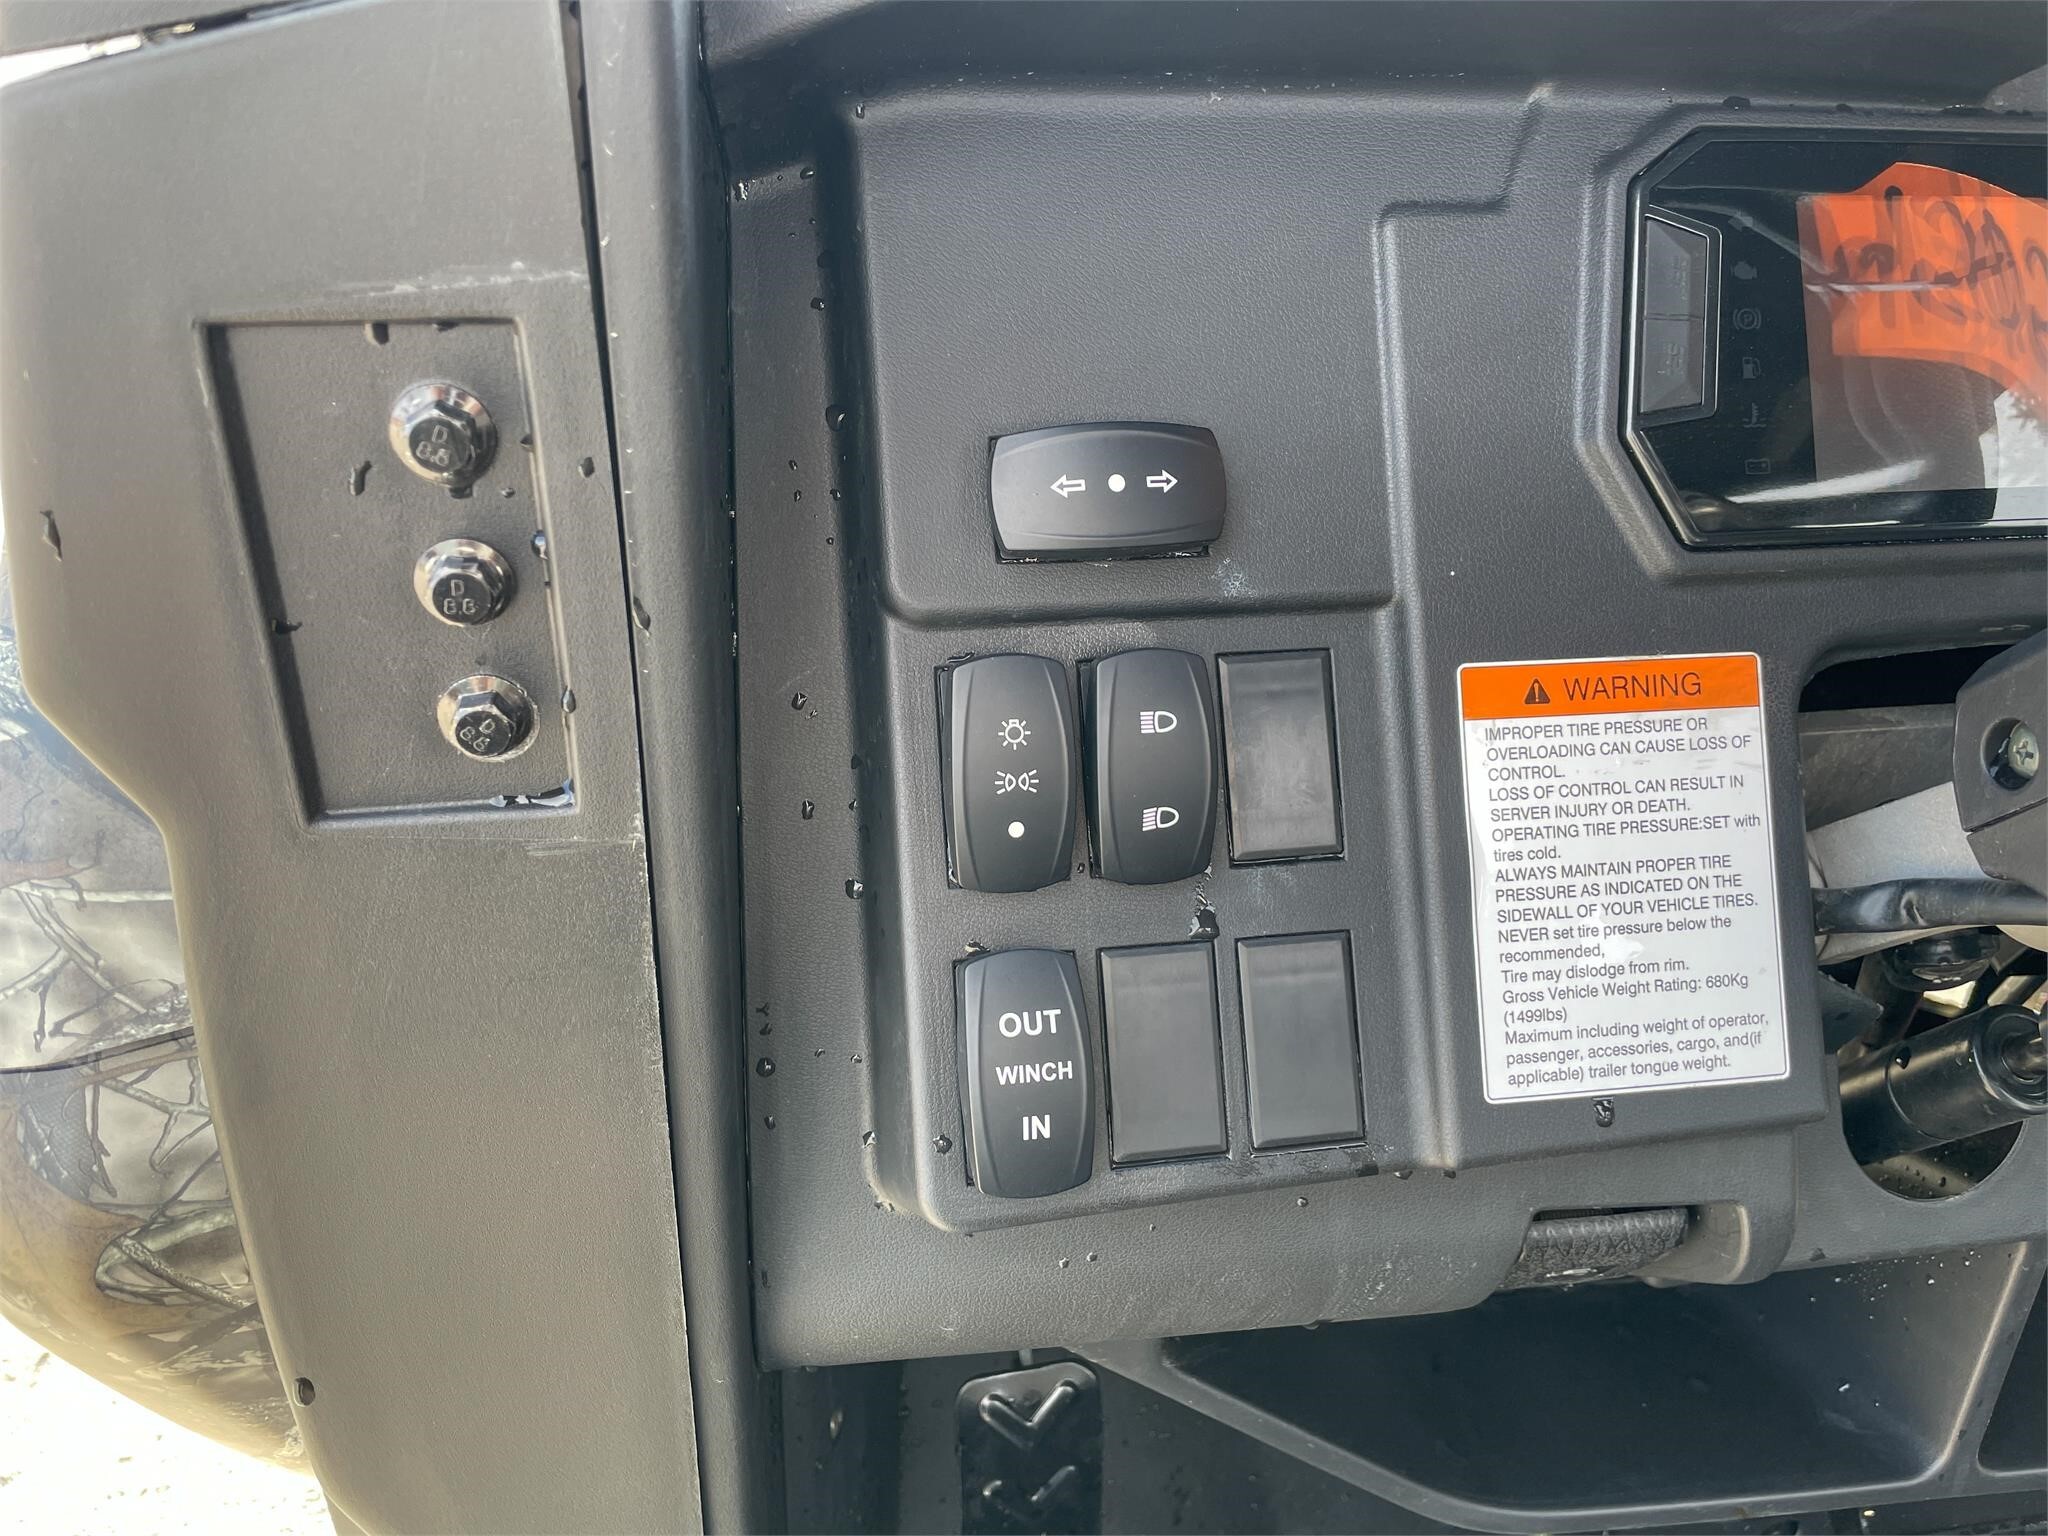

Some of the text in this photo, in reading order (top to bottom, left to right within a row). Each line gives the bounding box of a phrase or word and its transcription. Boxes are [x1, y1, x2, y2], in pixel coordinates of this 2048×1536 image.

[450, 579, 464, 596] D
[1563, 672, 1701, 701] WARNING
[1485, 717, 1708, 741] IMPROPER TIRE PRESSURE OR
[1485, 735, 1752, 762] OVERLOADING CAN CAUSE LOSS OF
[1488, 764, 1566, 782] CONTROL.
[1489, 774, 1744, 802] LOSS OF CONTROL CAN RESULT IN
[1490, 798, 1691, 822] SERVER INJURY OR DEATH.
[1492, 823, 1580, 842] OPERATING
[1582, 821, 1617, 837] TIRE
[1733, 813, 1761, 828] with
[1493, 845, 1561, 862] tires cold.
[1495, 854, 1732, 883] ALWAYS MAINTAIN PROPER TIRE
[1495, 873, 1743, 903] PRESSURE AS INDICATED ON THE
[1497, 892, 1758, 924] SIDEWALL OF YOUR VEHICLE TIRES.
[1498, 915, 1732, 944] NEVER set tire pressure below the
[1500, 958, 1689, 984] Tire may dislodge from rim.
[1502, 972, 1749, 1004] Gross Vehicle Weight Rating: 680Kg
[999, 1008, 1062, 1038] OUT
[1504, 1006, 1568, 1028] (1499lbs)
[1505, 1013, 1768, 1045] Maximum including weight of operator,
[1506, 1049, 1584, 1069] passenger,
[1587, 1039, 1673, 1059] accessories,
[1676, 1038, 1720, 1053] cargo,
[996, 1060, 1073, 1085] WINCH
[1508, 1054, 1731, 1088] applicable) trailer tongue weight.
[1022, 1114, 1051, 1141] IN
